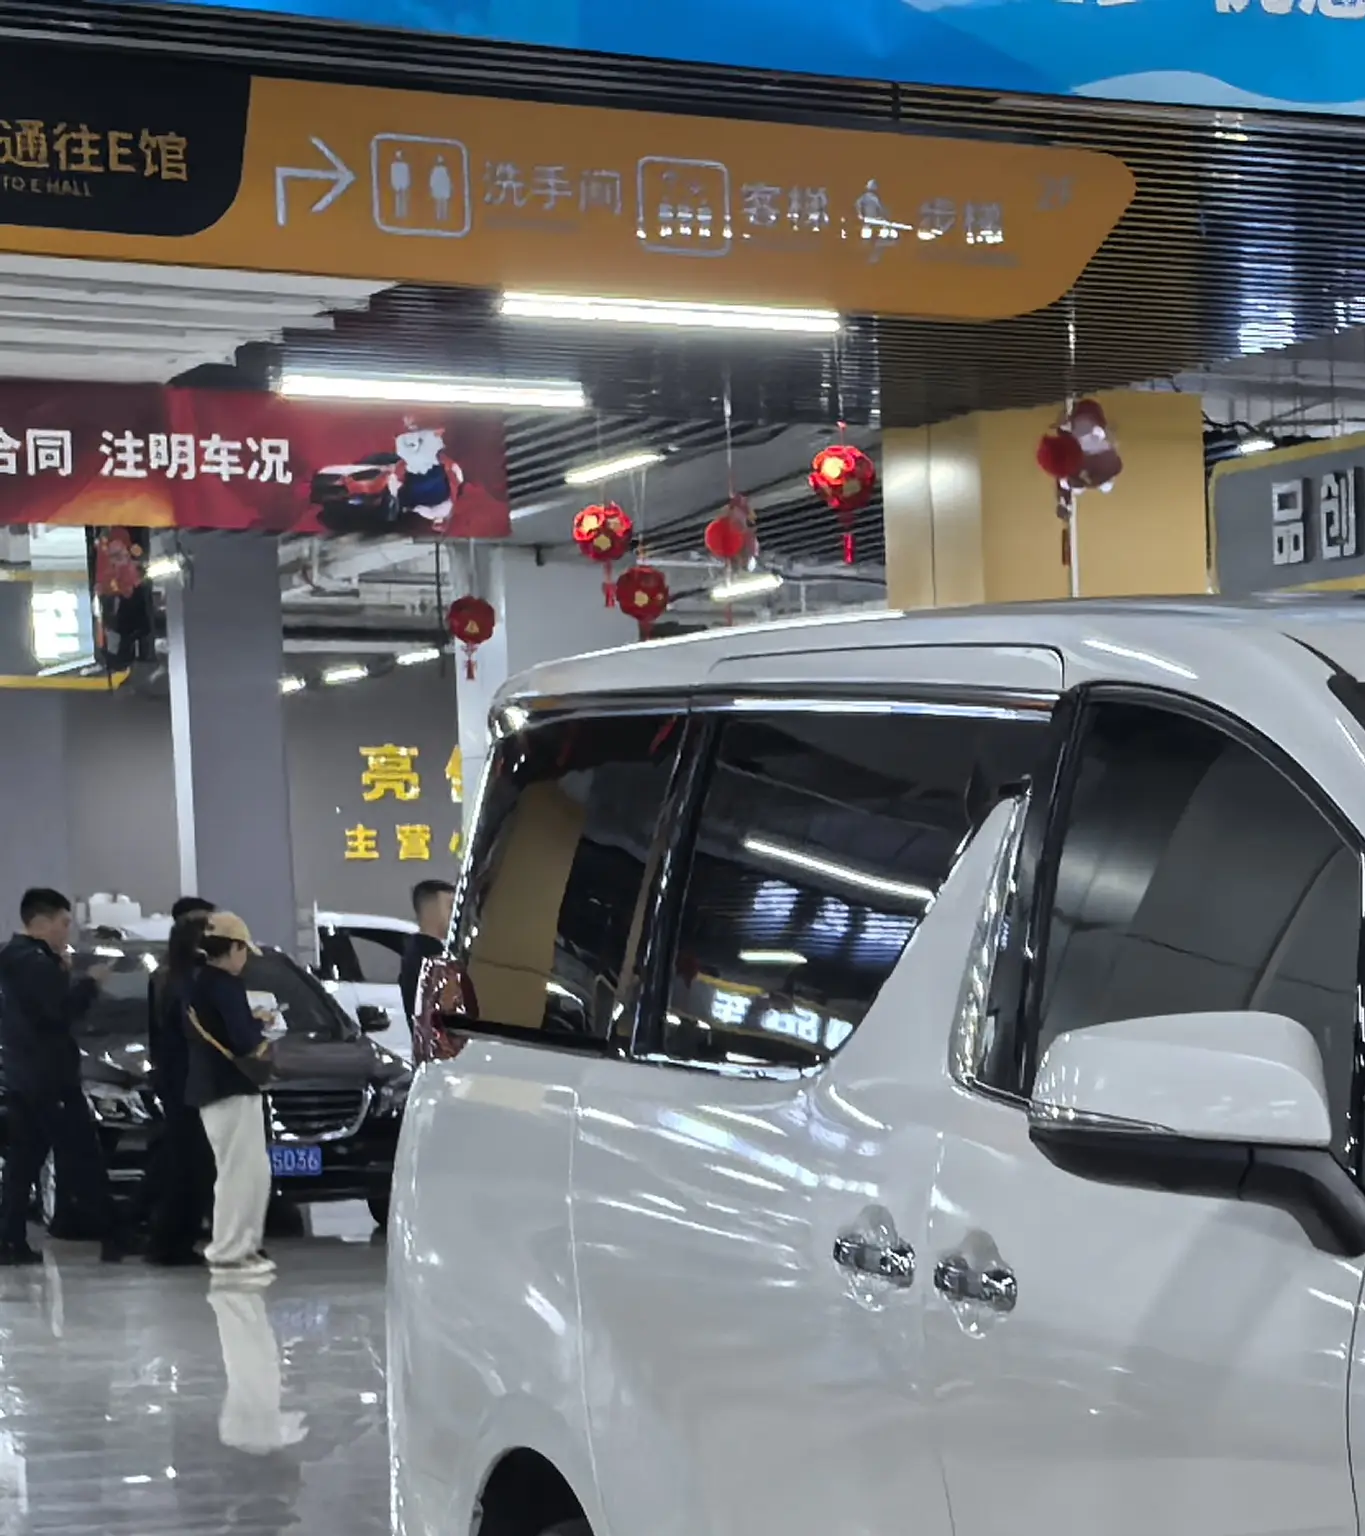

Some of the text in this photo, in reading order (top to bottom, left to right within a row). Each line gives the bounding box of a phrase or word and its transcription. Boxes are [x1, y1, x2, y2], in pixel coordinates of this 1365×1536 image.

[0, 118, 188, 181] 通往E馆
[482, 161, 622, 214] 洗手间
[99, 430, 293, 483] 注明车况
[344, 823, 462, 861] 主营
